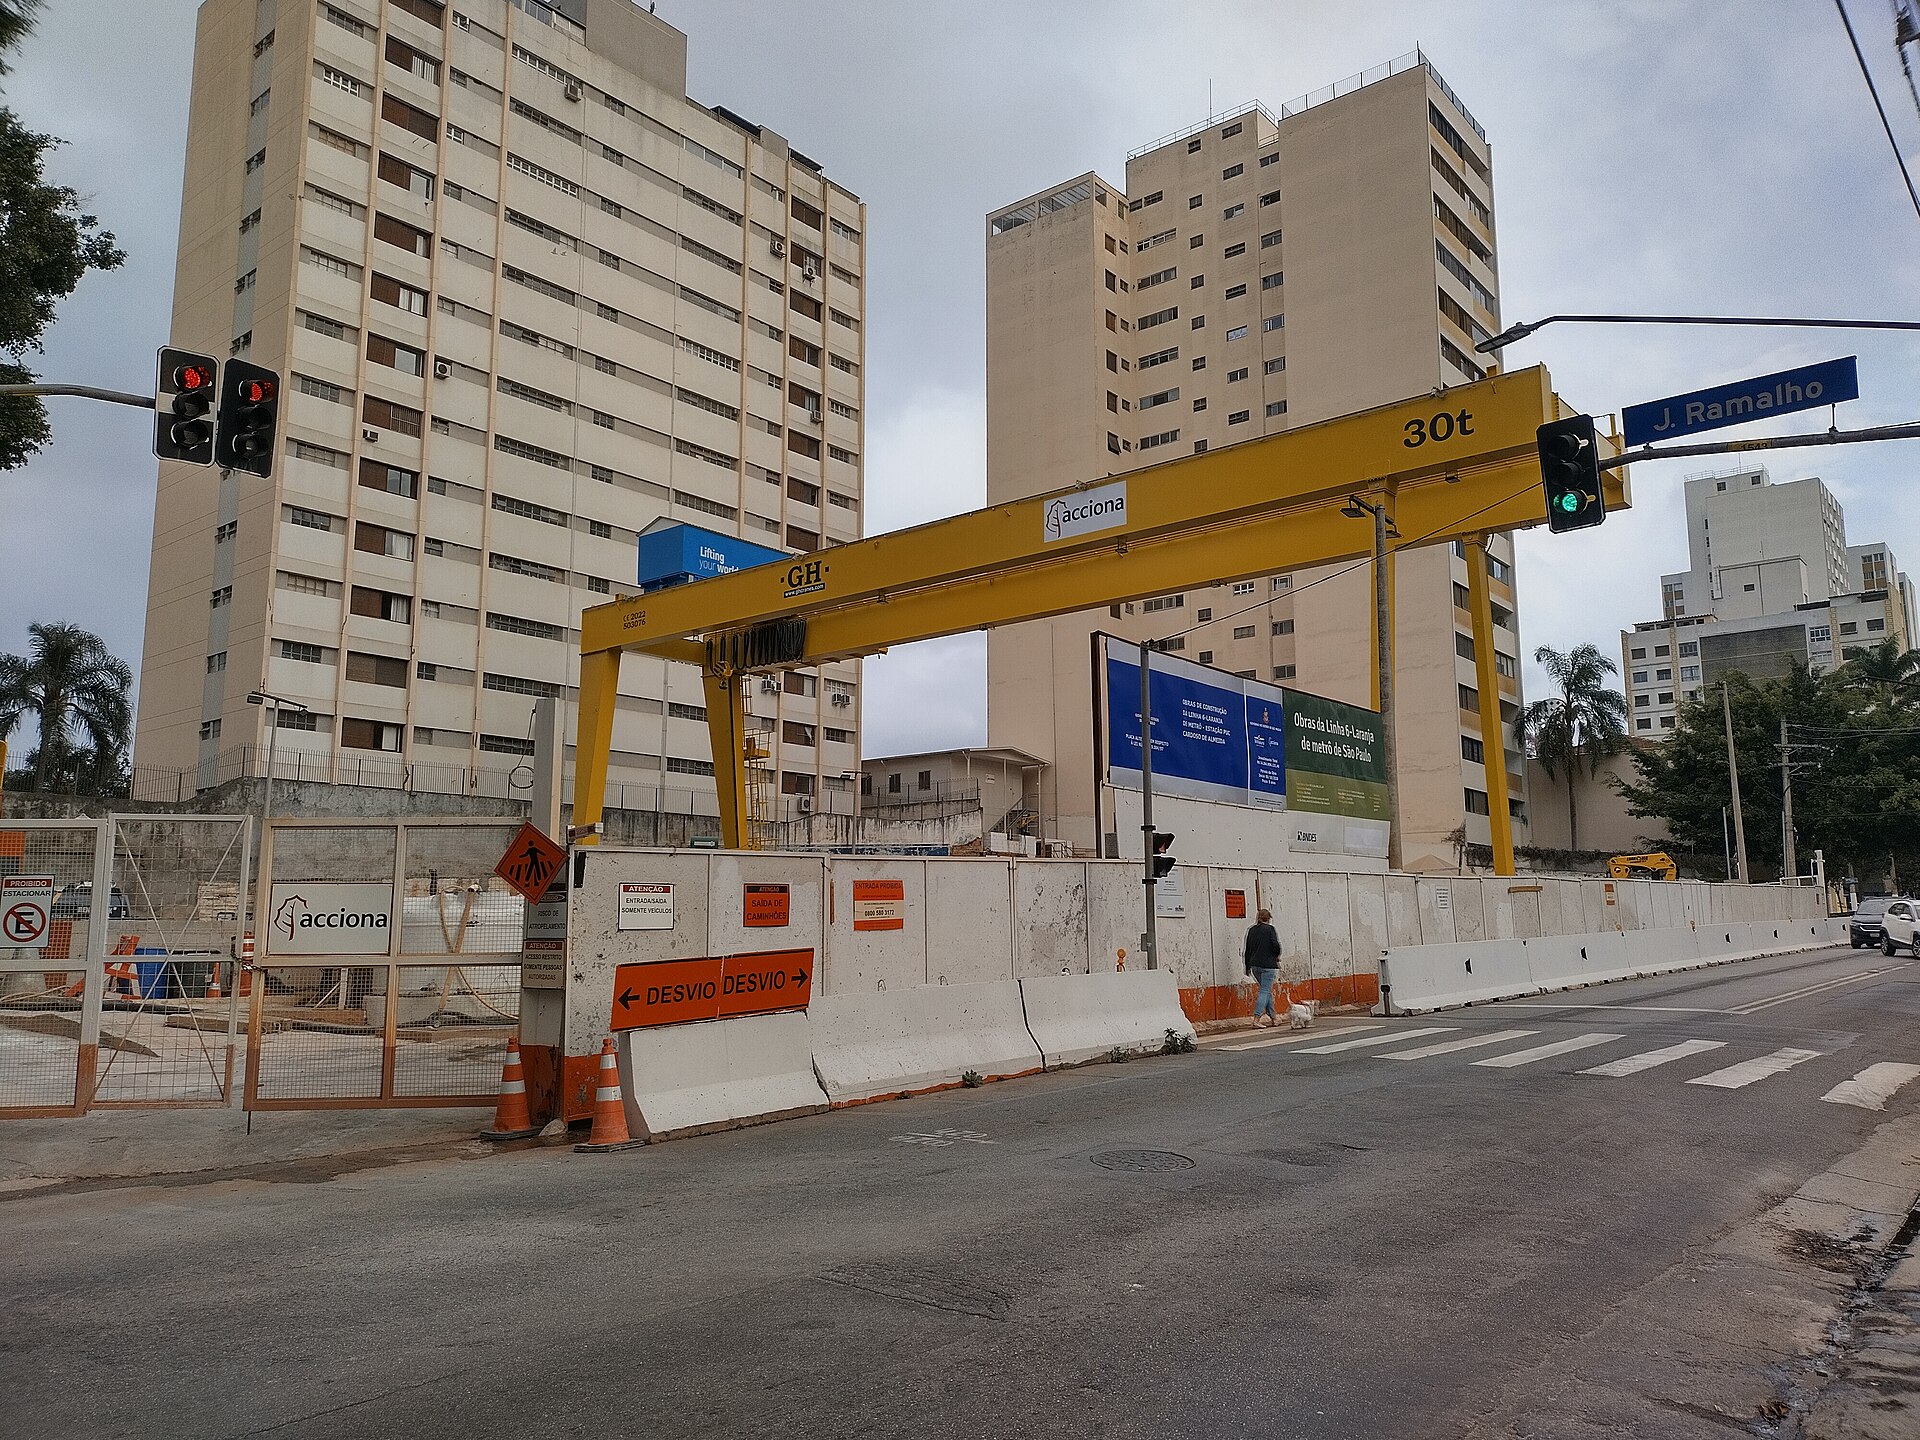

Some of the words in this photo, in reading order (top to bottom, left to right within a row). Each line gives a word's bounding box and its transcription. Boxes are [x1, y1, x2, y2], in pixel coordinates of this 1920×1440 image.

[1652, 407, 1677, 432] J.
[1685, 381, 1824, 426] Ramalho
[1403, 408, 1475, 448] 30t
[1062, 497, 1124, 523] acciona
[700, 546, 725, 565] Lifting
[699, 559, 717, 571] your
[630, 610, 646, 620] 2022
[623, 619, 646, 630] 503076
[1182, 698, 1196, 708] OBRAS
[1196, 701, 1202, 709] DE
[1202, 703, 1228, 716] CONSTRUÇÃO
[1188, 711, 1202, 720] LINHA
[1205, 725, 1223, 735] ESTAÇÃO
[1294, 712, 1316, 730] Obras
[1316, 716, 1325, 732] da
[1325, 719, 1345, 736] Linha
[1345, 724, 1375, 745] 6-Laranja
[1182, 730, 1202, 740] CARDOSO
[1201, 734, 1207, 742] DE
[1301, 736, 1311, 751] de
[1311, 740, 1333, 755] metrô
[1333, 741, 1342, 757] de
[1342, 744, 1355, 759] São
[1355, 746, 1372, 763] Paulo
[1302, 832, 1317, 843] BNDES
[628, 885, 664, 893] ATENÇÃO
[751, 898, 773, 907] SAÍDA
[774, 899, 783, 907] DE
[299, 907, 388, 928] acciona
[746, 911, 787, 920] CAMINHÕES
[529, 922, 566, 930] ATROPELAMENTO
[528, 942, 557, 950] ATENÇÃO
[541, 953, 562, 961] RESTRITO
[542, 963, 563, 971] PESSOAS
[722, 970, 786, 995] DESVIO
[646, 981, 716, 1006] DESVIO
